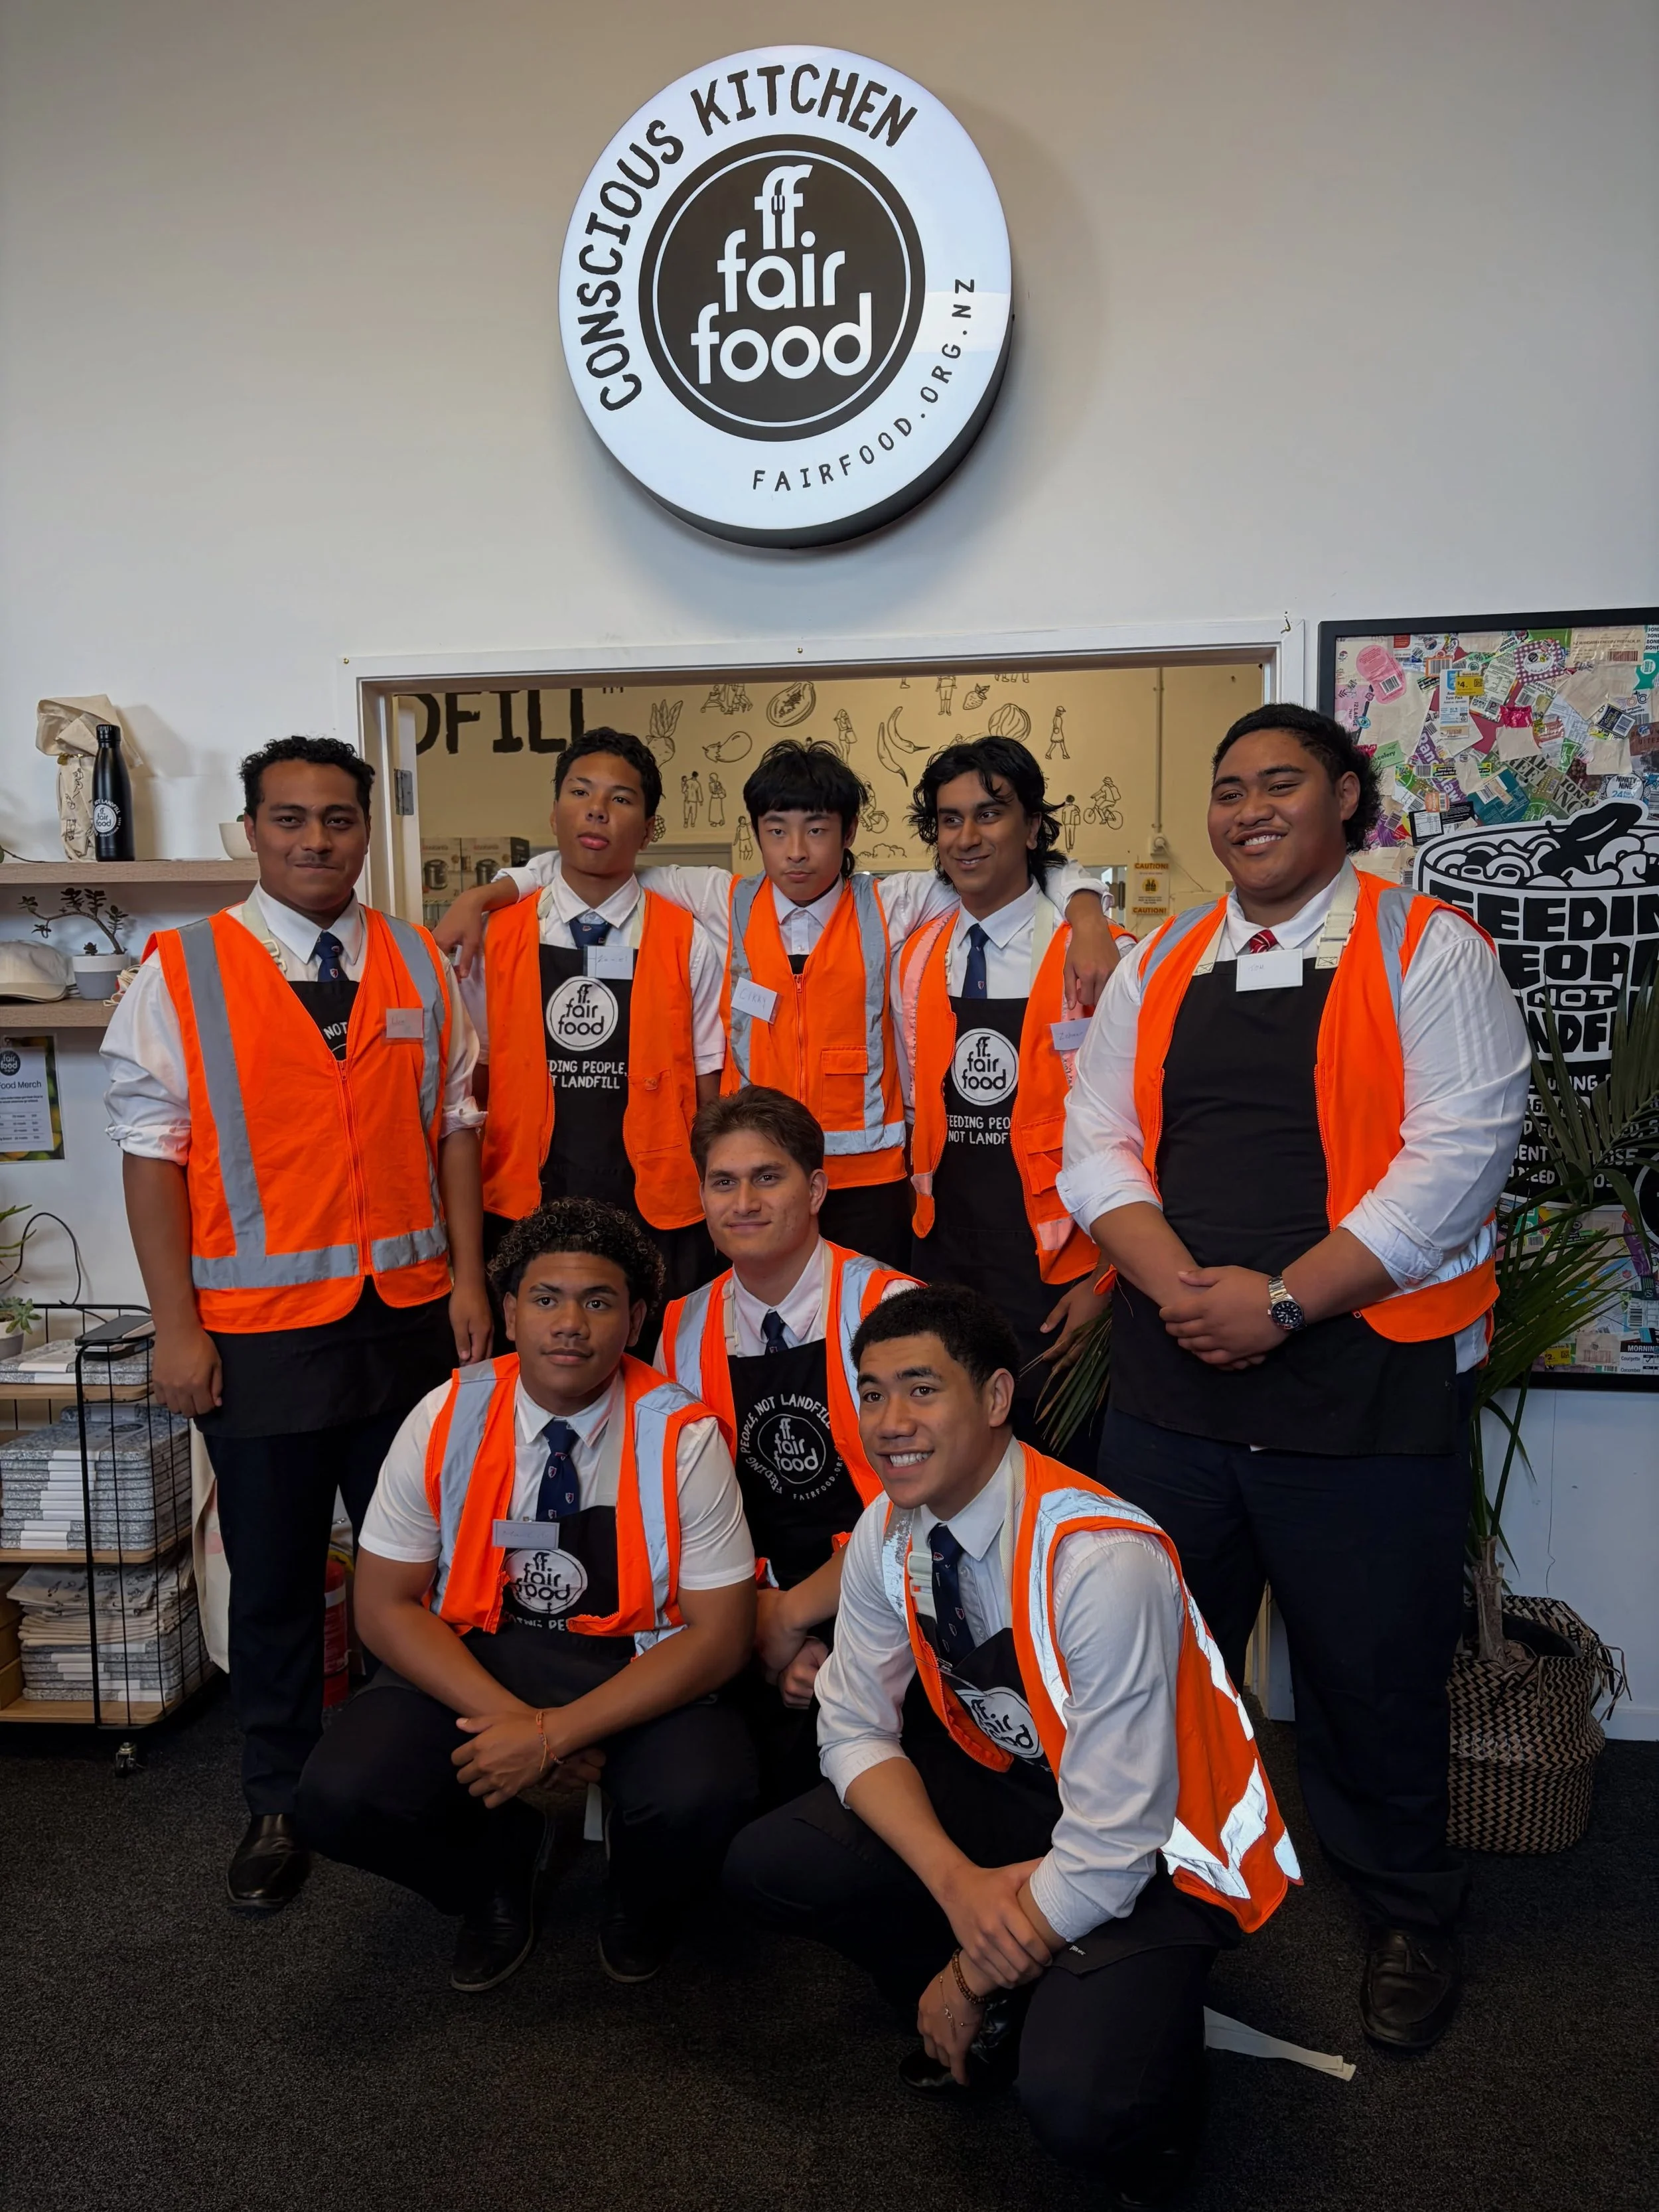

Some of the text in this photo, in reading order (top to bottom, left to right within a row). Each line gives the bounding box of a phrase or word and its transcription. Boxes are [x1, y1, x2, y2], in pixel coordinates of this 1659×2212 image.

[576, 64, 918, 411] CONSCIOUS KITCHEN
[717, 229, 845, 313] fair
[691, 292, 872, 385] food
[753, 278, 975, 492] FAIRFOOD.ORG.NZ
[566, 997, 599, 1018] fair
[1534, 988, 1613, 1007] NOT
[323, 1021, 348, 1040] NOT
[558, 1014, 605, 1036] food
[1, 1060, 18, 1070] food
[582, 1061, 628, 1076] PEOPLE,
[967, 1051, 1000, 1073] fair
[18, 1080, 42, 1089] Merch
[561, 1075, 620, 1089] LANDFILL
[962, 1069, 1007, 1090] food
[948, 1130, 966, 1143] NOT
[754, 1396, 776, 1416] NOT
[740, 1412, 758, 1454] PEOPLE,
[774, 1432, 805, 1455] fair
[774, 1447, 819, 1472] food
[745, 1457, 782, 1495] FEEDING
[524, 1562, 561, 1587] fair
